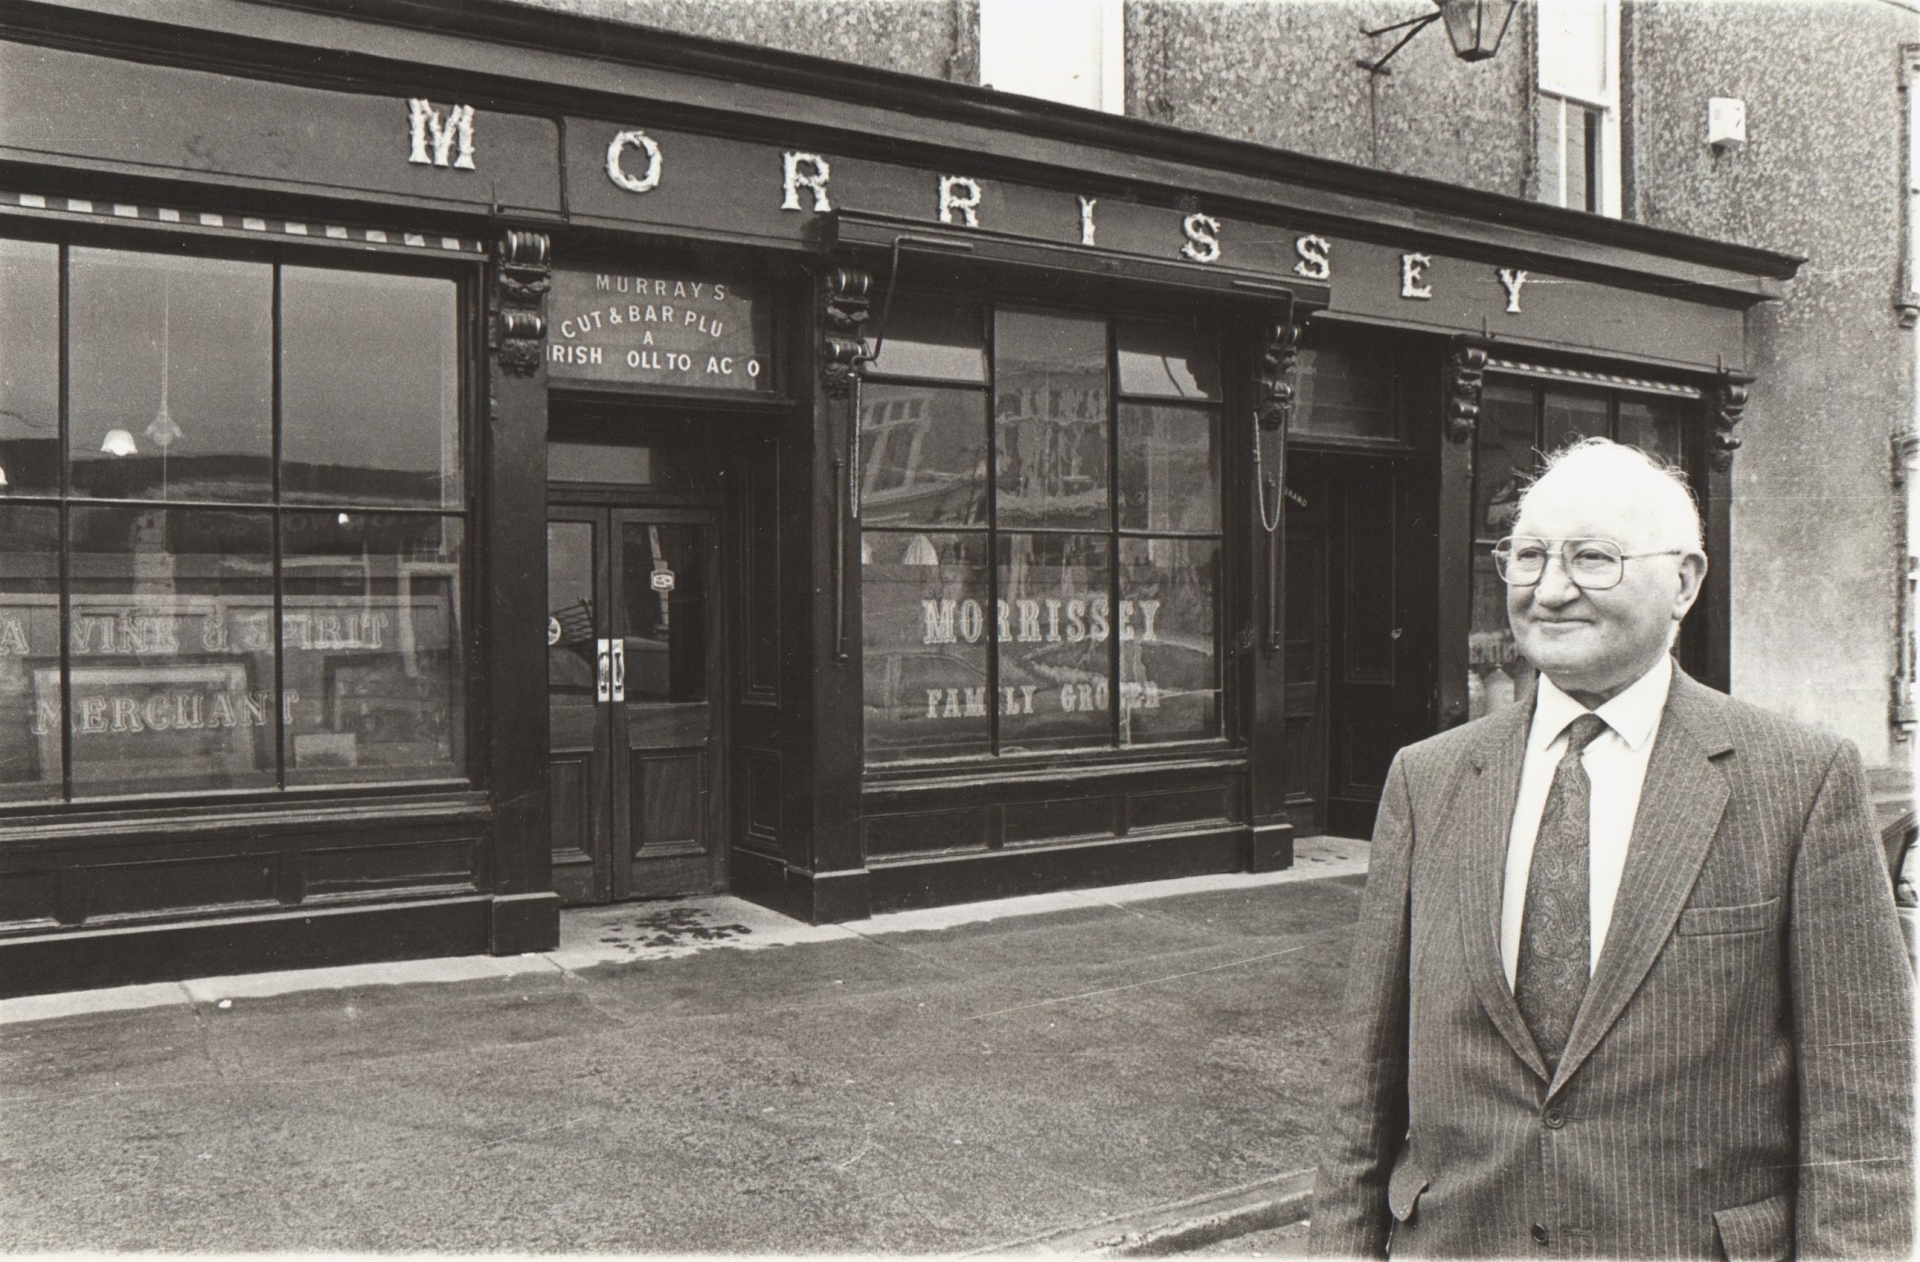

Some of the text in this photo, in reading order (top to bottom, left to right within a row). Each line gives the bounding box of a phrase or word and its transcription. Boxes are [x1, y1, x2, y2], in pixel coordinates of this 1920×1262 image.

[408, 97, 1529, 314] MORRISSEY
[561, 310, 602, 339] CUT
[629, 304, 674, 323] BAR
[685, 310, 723, 338] PLU
[642, 330, 654, 346] A
[922, 598, 1161, 645] MORRISSEY
